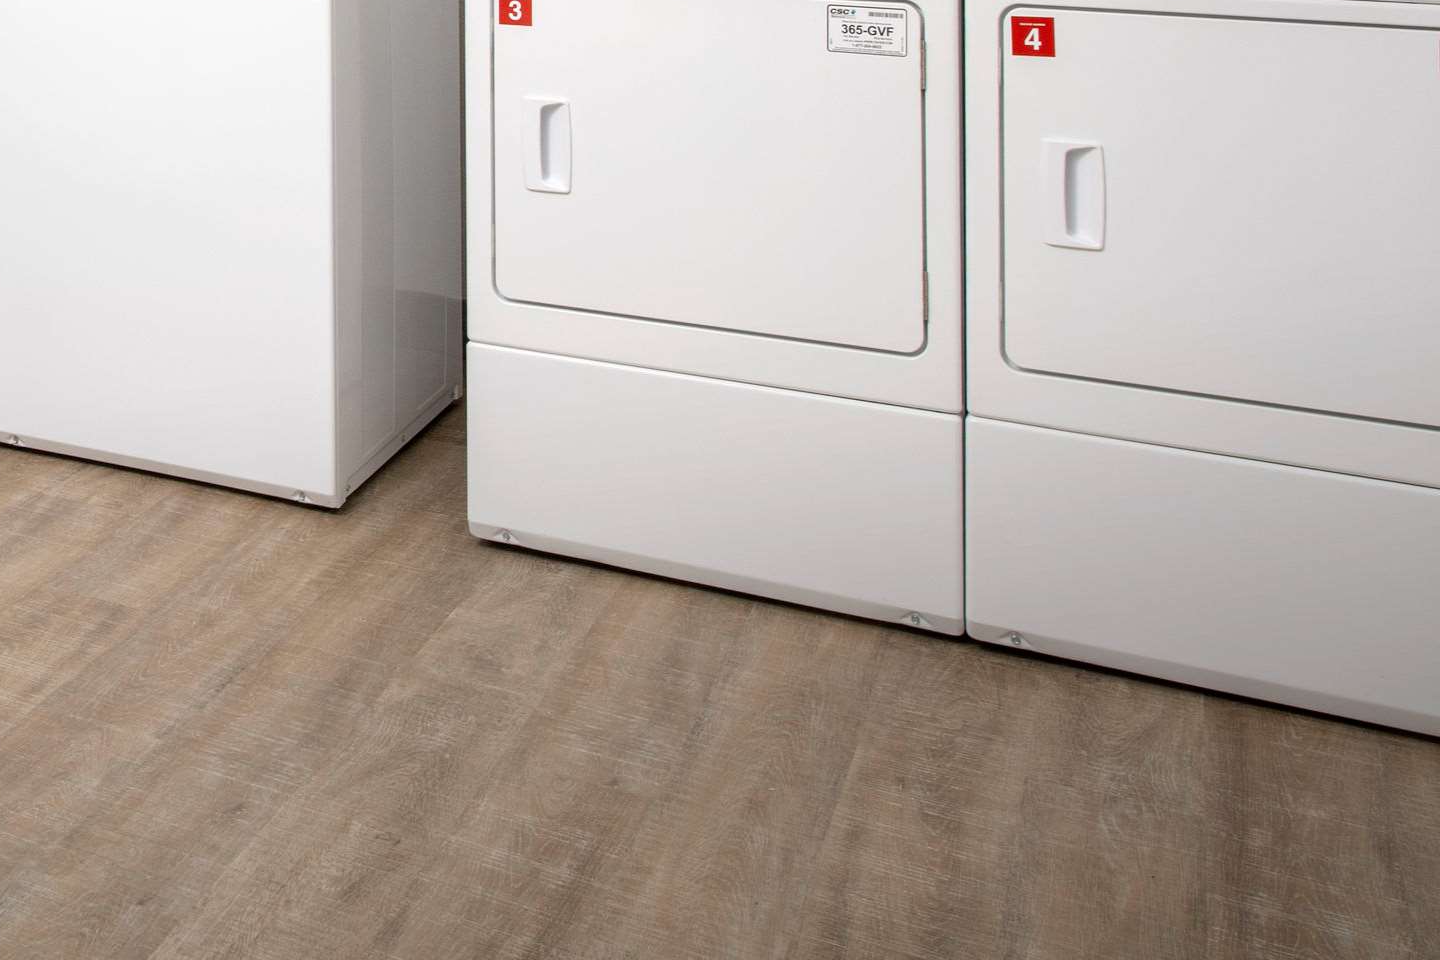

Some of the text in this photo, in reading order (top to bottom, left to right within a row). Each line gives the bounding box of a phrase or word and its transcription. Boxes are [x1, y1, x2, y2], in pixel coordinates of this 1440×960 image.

[508, 0, 523, 21] 3
[841, 24, 895, 37] 365-GVF
[1023, 27, 1043, 51] 4
